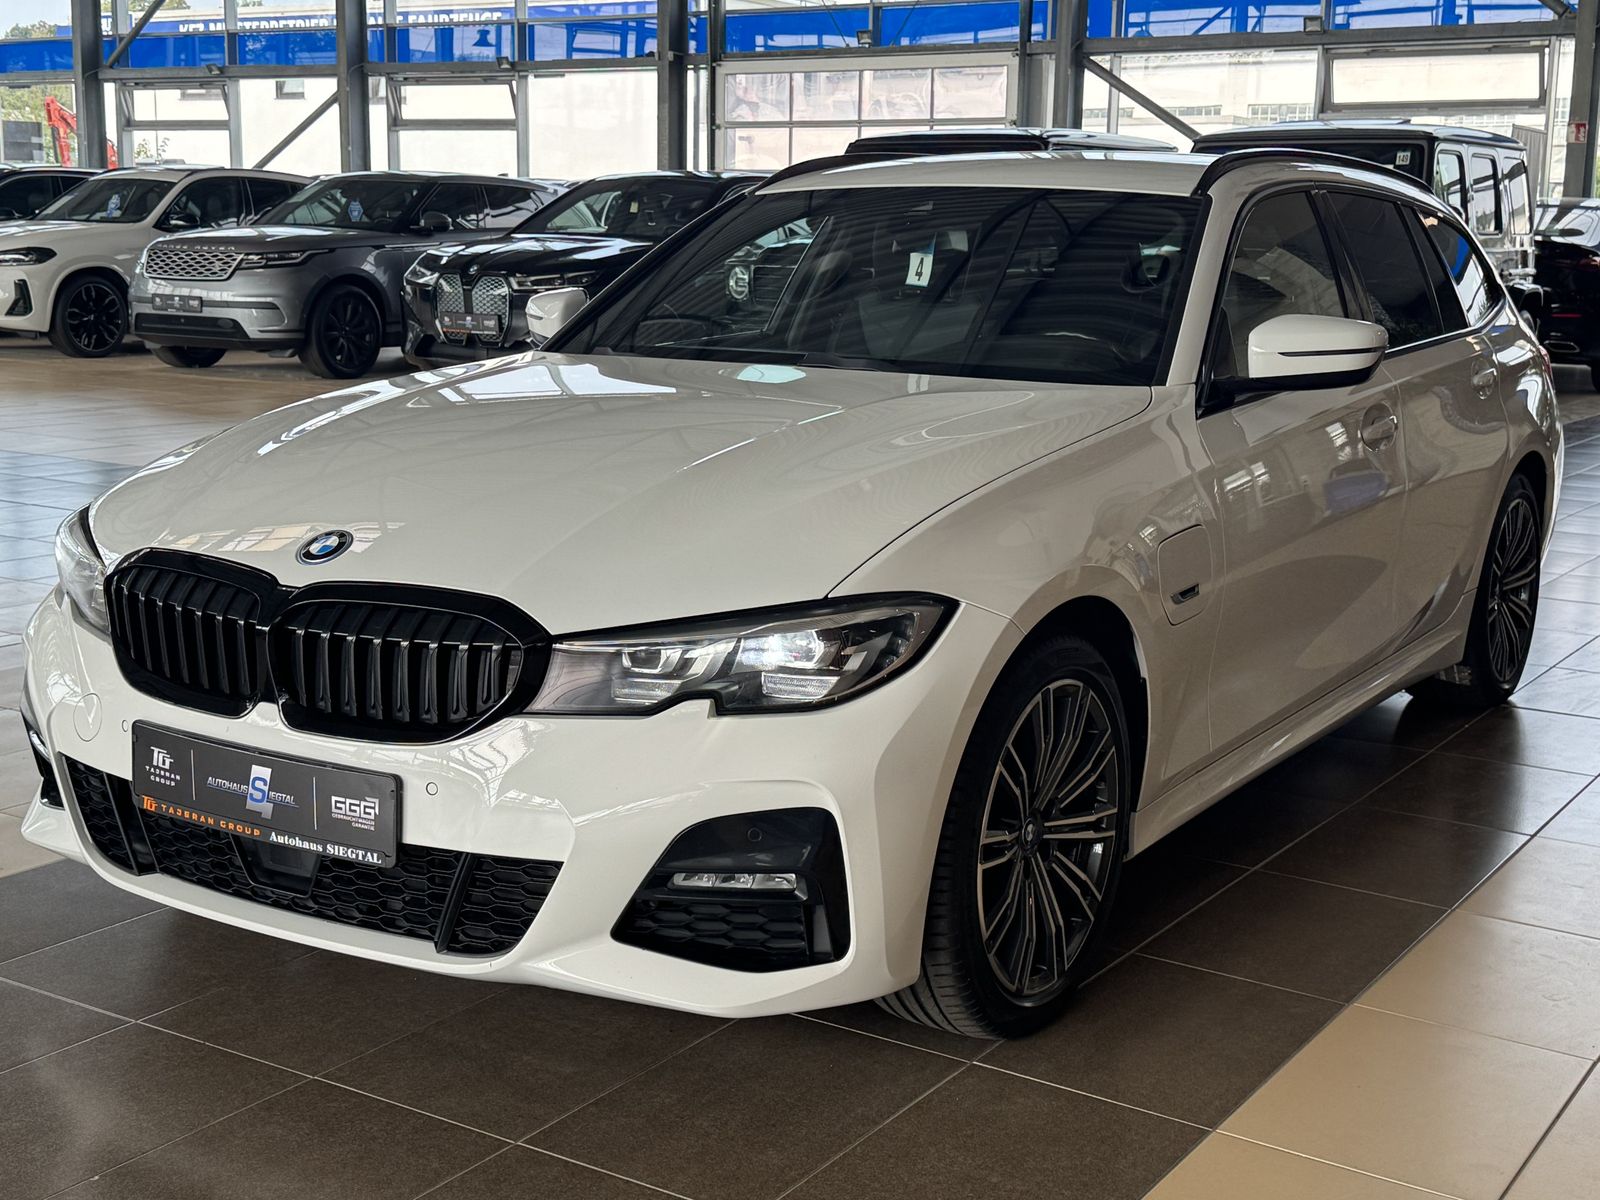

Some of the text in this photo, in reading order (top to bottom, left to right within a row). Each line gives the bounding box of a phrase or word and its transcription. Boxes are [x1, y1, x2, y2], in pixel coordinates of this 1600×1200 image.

[915, 257, 925, 281] 4
[150, 775, 176, 787] GROUP
[207, 776, 249, 794] AUTOHAUS
[220, 820, 261, 836] GROUP
[269, 831, 382, 864] Autohaus SIEGTAL
